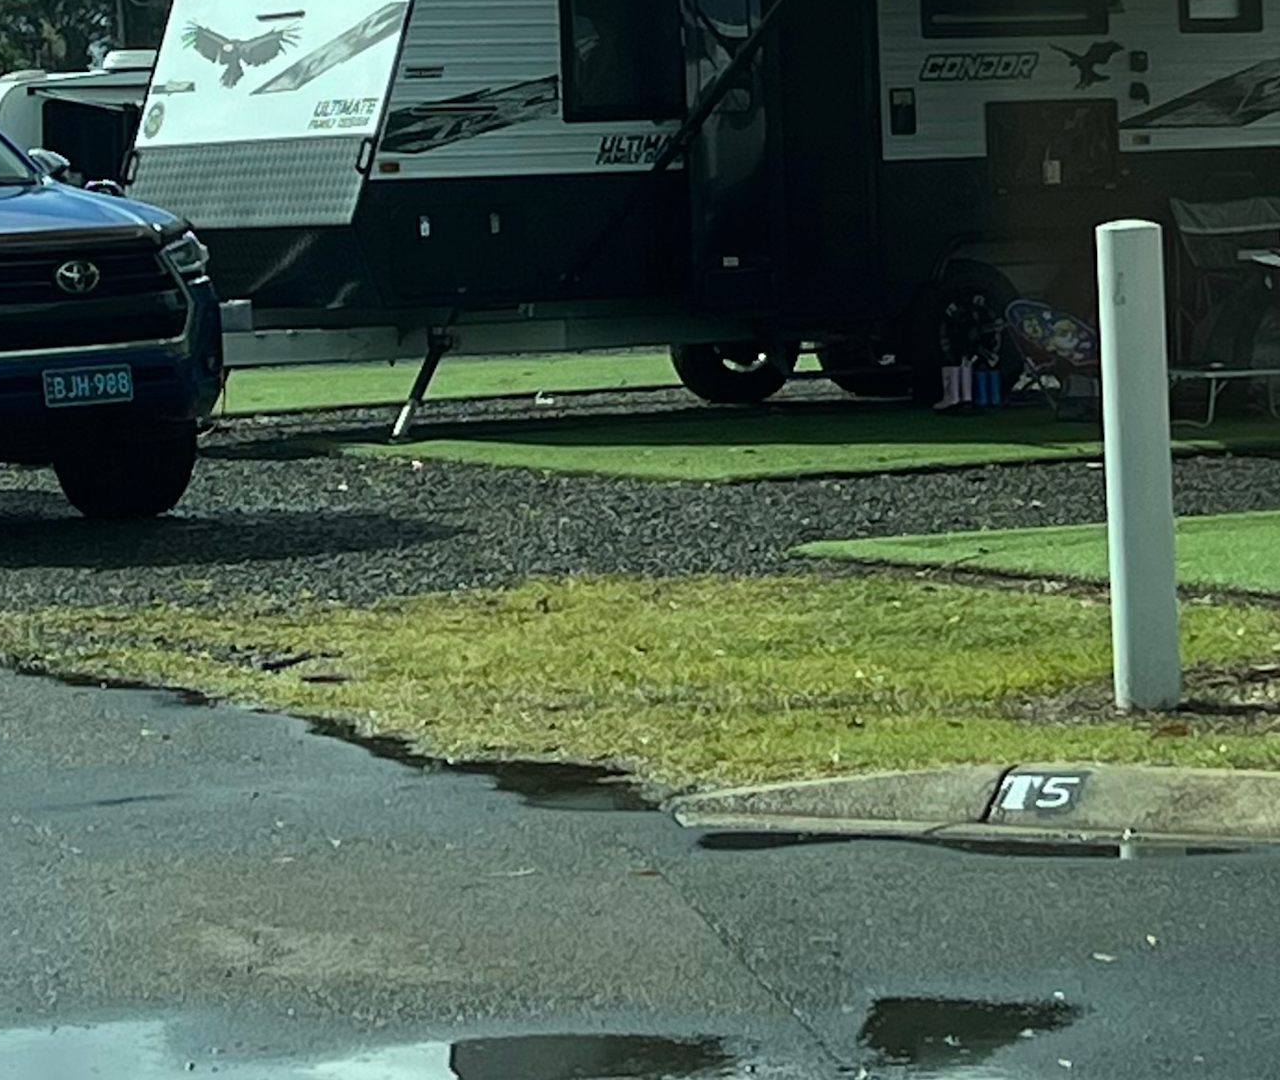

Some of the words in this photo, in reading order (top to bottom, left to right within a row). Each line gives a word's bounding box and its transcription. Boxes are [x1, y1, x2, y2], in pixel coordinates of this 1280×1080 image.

[920, 52, 1039, 81] CONDOR
[314, 98, 379, 117] ULTIMATE
[1001, 775, 1080, 810] T5
